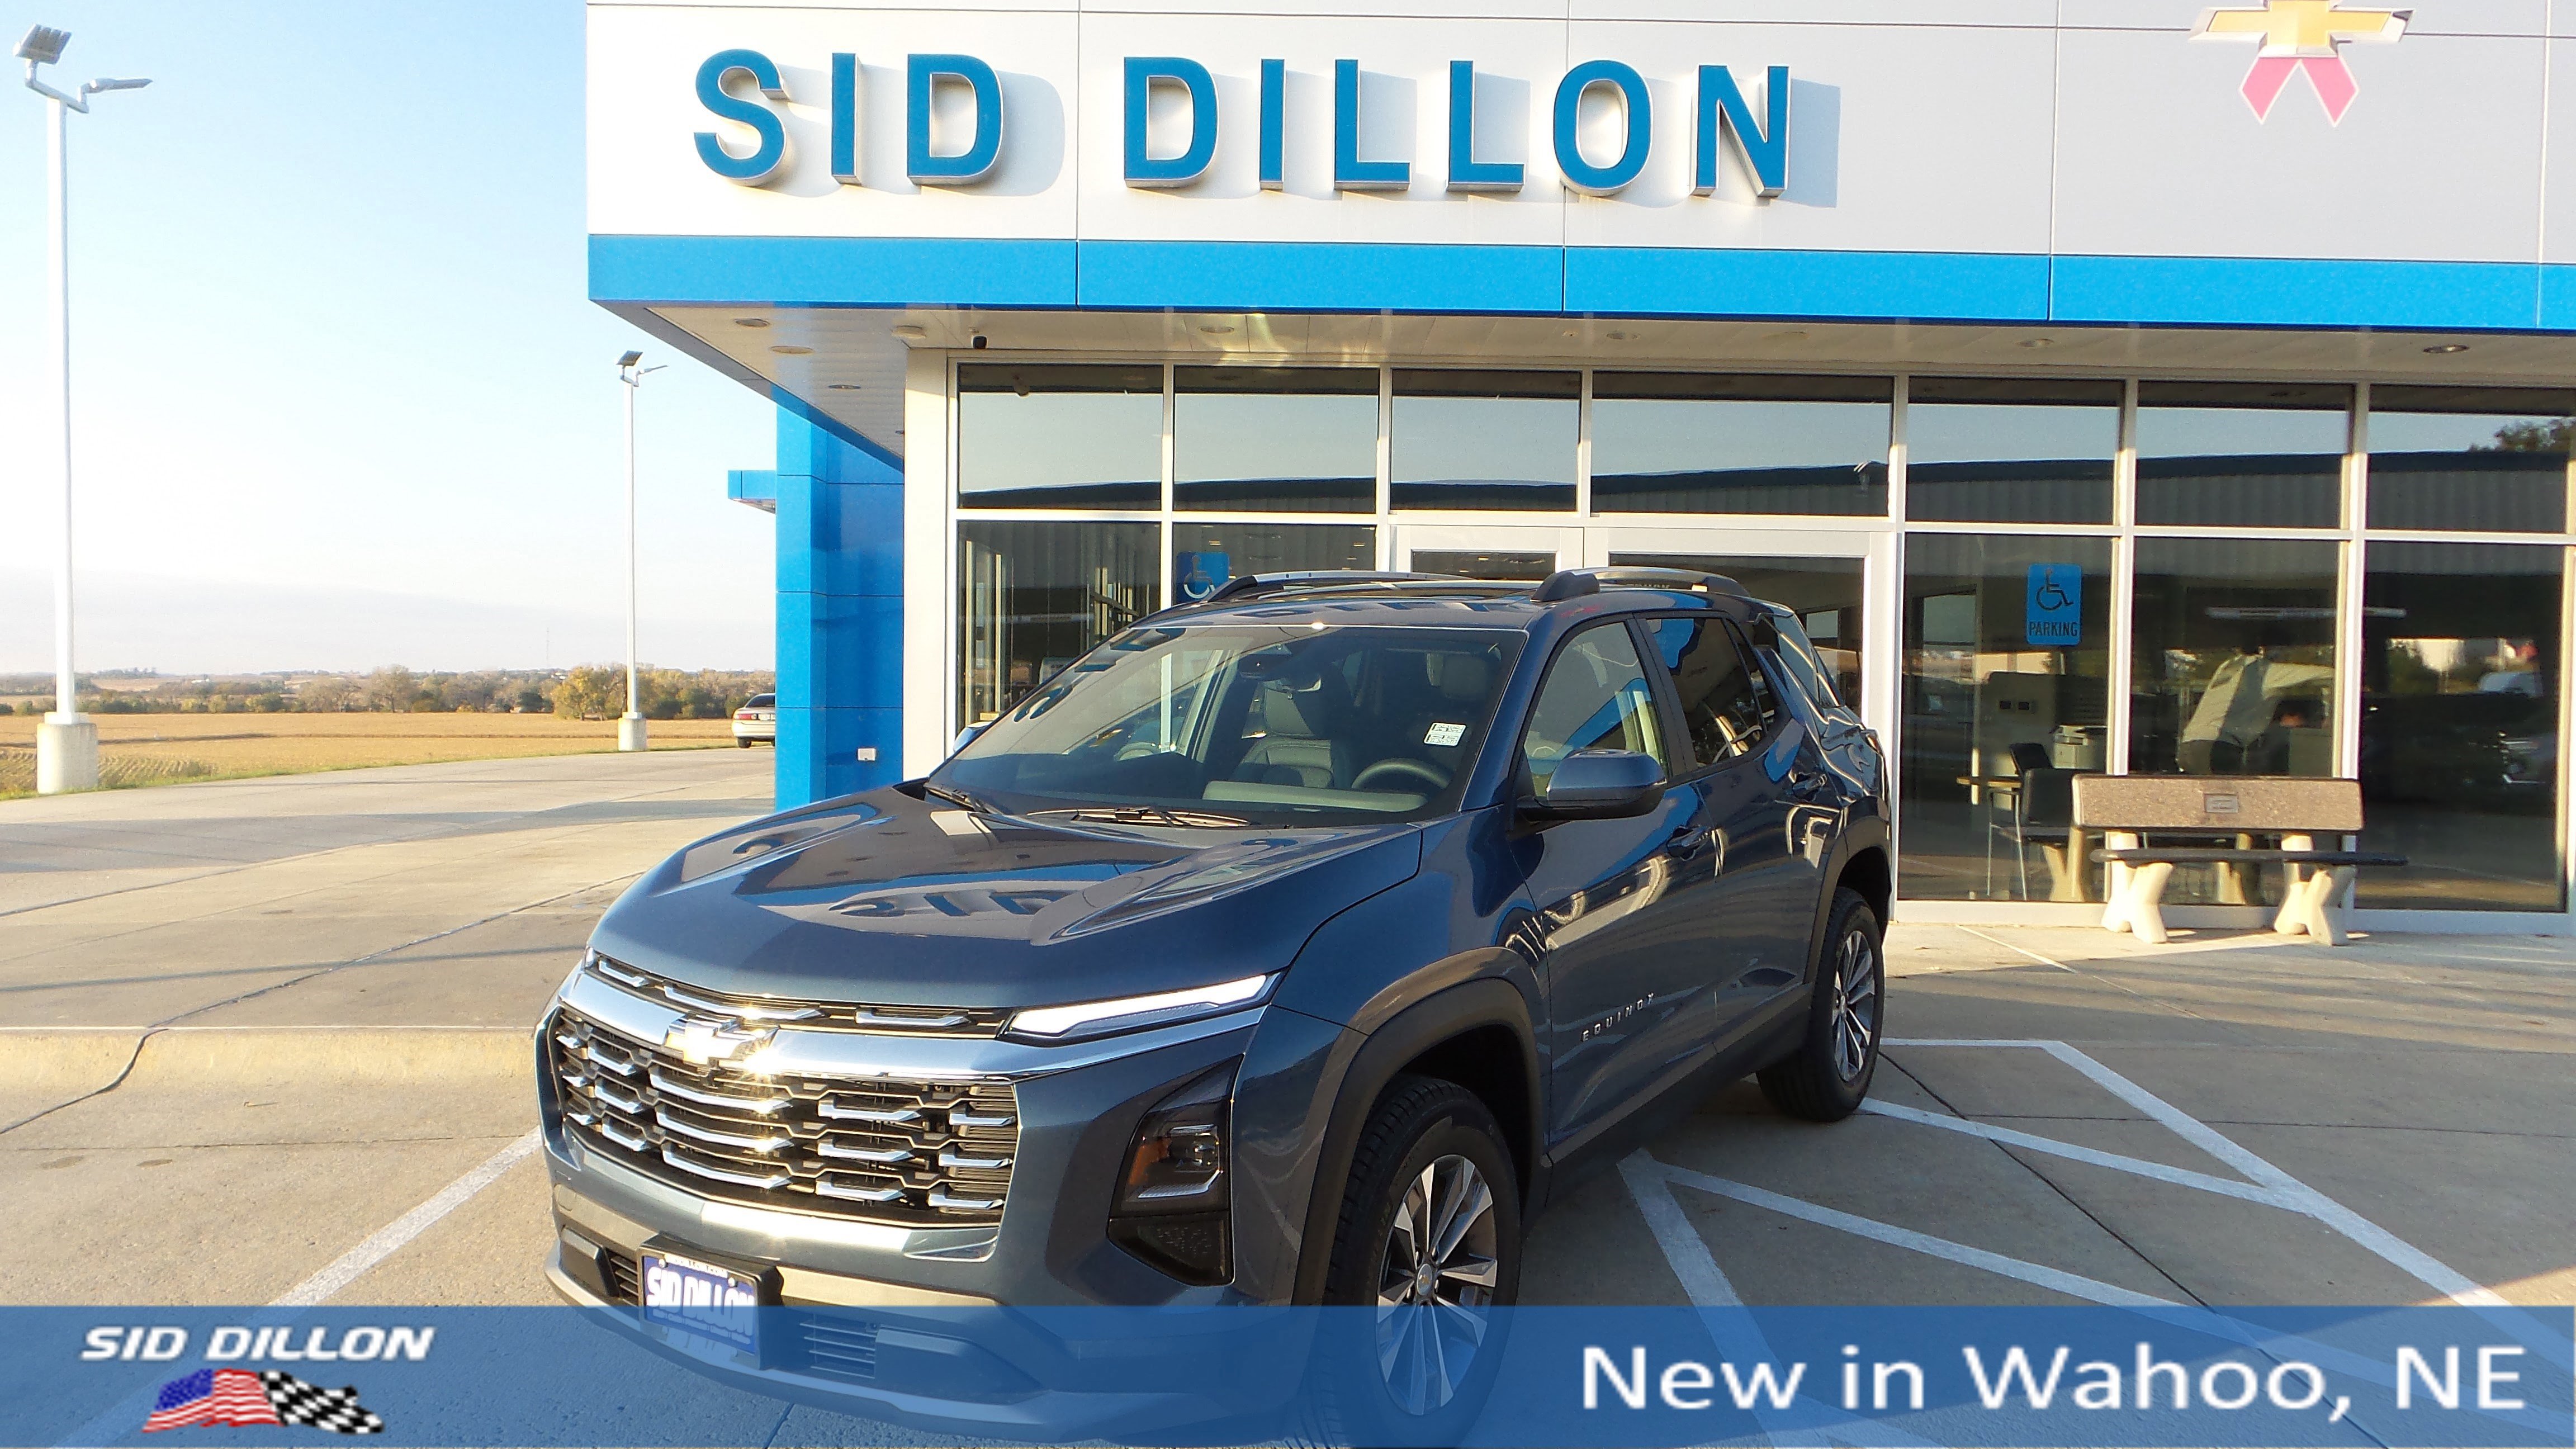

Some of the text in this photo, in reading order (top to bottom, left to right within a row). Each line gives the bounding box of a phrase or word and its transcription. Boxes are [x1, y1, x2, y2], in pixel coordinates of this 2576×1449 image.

[693, 48, 1791, 195] SID DILLON
[2029, 621, 2078, 637] PARKING
[646, 1266, 681, 1314] SID
[683, 1276, 755, 1337] DILLON
